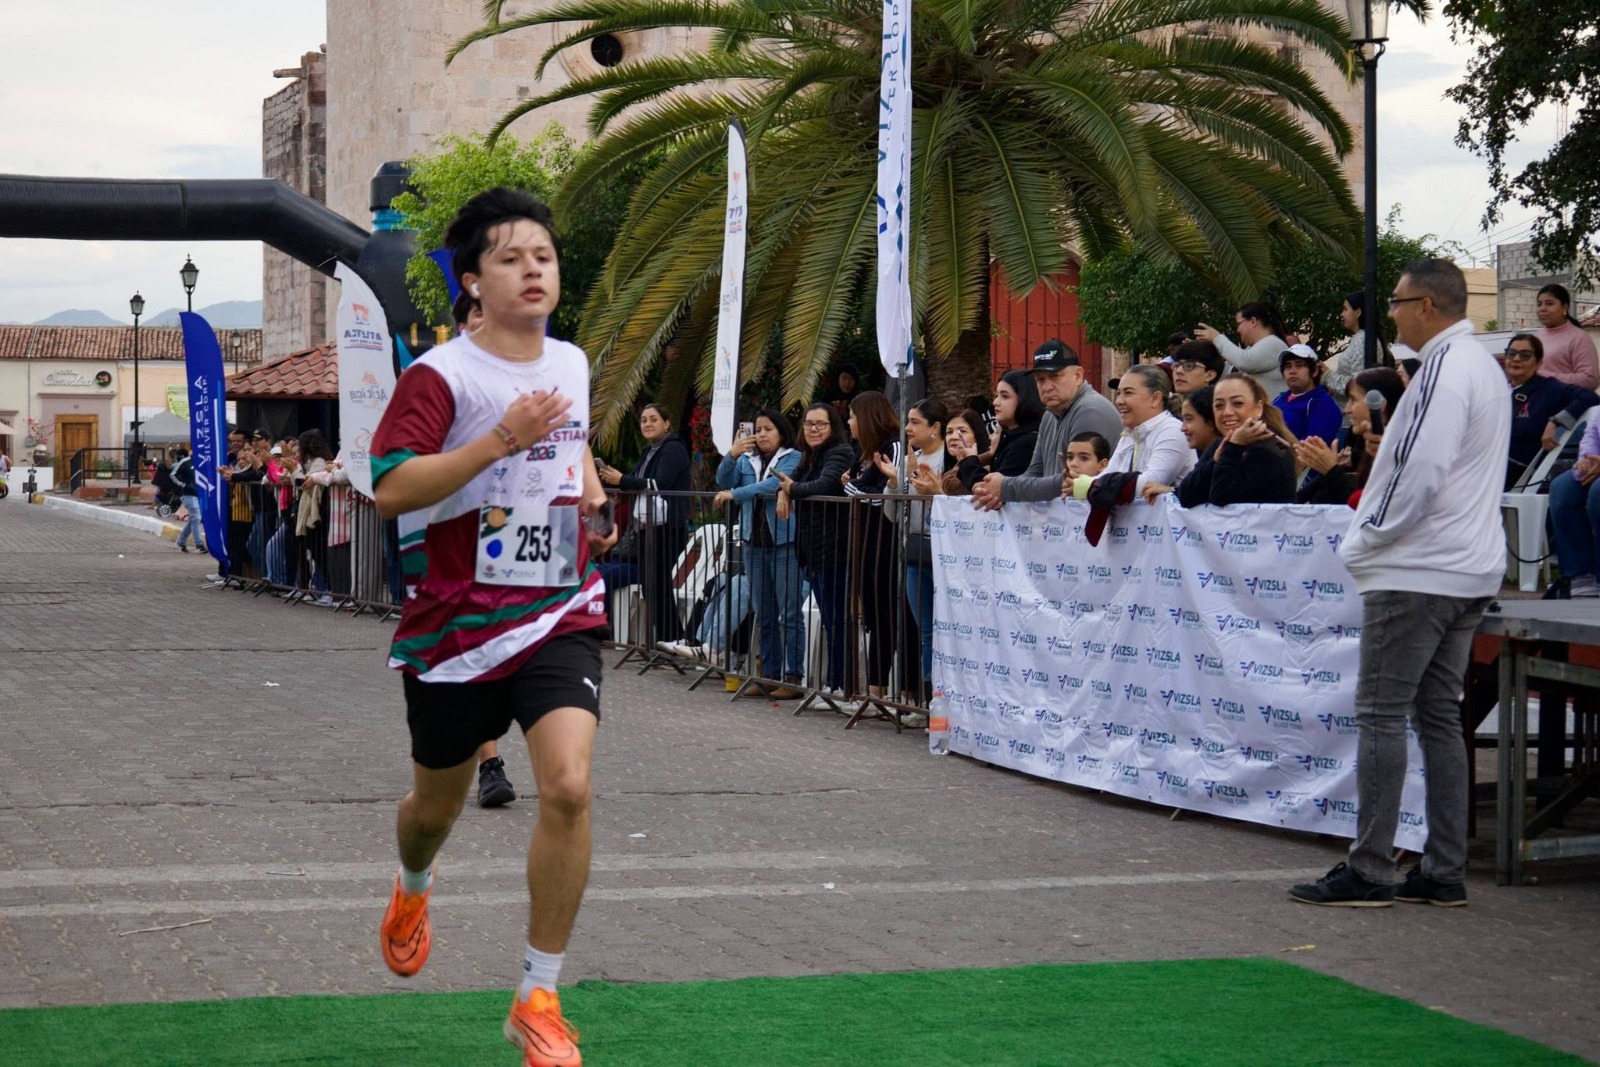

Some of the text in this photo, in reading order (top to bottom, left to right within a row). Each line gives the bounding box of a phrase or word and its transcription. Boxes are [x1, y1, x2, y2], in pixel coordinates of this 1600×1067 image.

[194, 376, 207, 467] VIZSLA
[203, 419, 212, 462] SILVER
[526, 445, 556, 461] 2026
[515, 525, 552, 562] 253
[1230, 534, 1258, 545] VIZSLA
[1287, 535, 1314, 547] VIZSLA
[995, 559, 1017, 570] VIZSLA
[1094, 566, 1112, 577] VIZSLA
[1258, 579, 1287, 591] VIZSLA
[1318, 582, 1345, 594] VIZSLA
[1003, 593, 1022, 605] VIZSLA
[1077, 603, 1094, 613] VIZSLA
[1229, 617, 1261, 630] VIZSLA
[1286, 623, 1314, 636] VIZSLA
[1019, 634, 1037, 645] VIZSLA
[1116, 645, 1138, 657] VIZSLA
[1154, 650, 1181, 663] VIZSLA
[992, 664, 1011, 677] VIZSLA
[1253, 664, 1283, 677] VIZSLA
[1031, 671, 1049, 683] VIZSLA
[1312, 671, 1341, 683] VIZSLA
[1173, 693, 1201, 706] VIZSLA
[1221, 701, 1245, 714] VIZSLA
[1271, 709, 1301, 722] VIZSLA
[1113, 725, 1133, 737] VIZSLA
[981, 735, 1000, 747] VIZSLA
[1148, 731, 1177, 745] VIZSLA
[1016, 743, 1036, 755] VIZSLA
[1252, 749, 1279, 761] VIZSLA
[1311, 757, 1343, 770] VIZSLA
[1166, 773, 1189, 788] VIZSLA
[1214, 784, 1248, 799] VIZSLA
